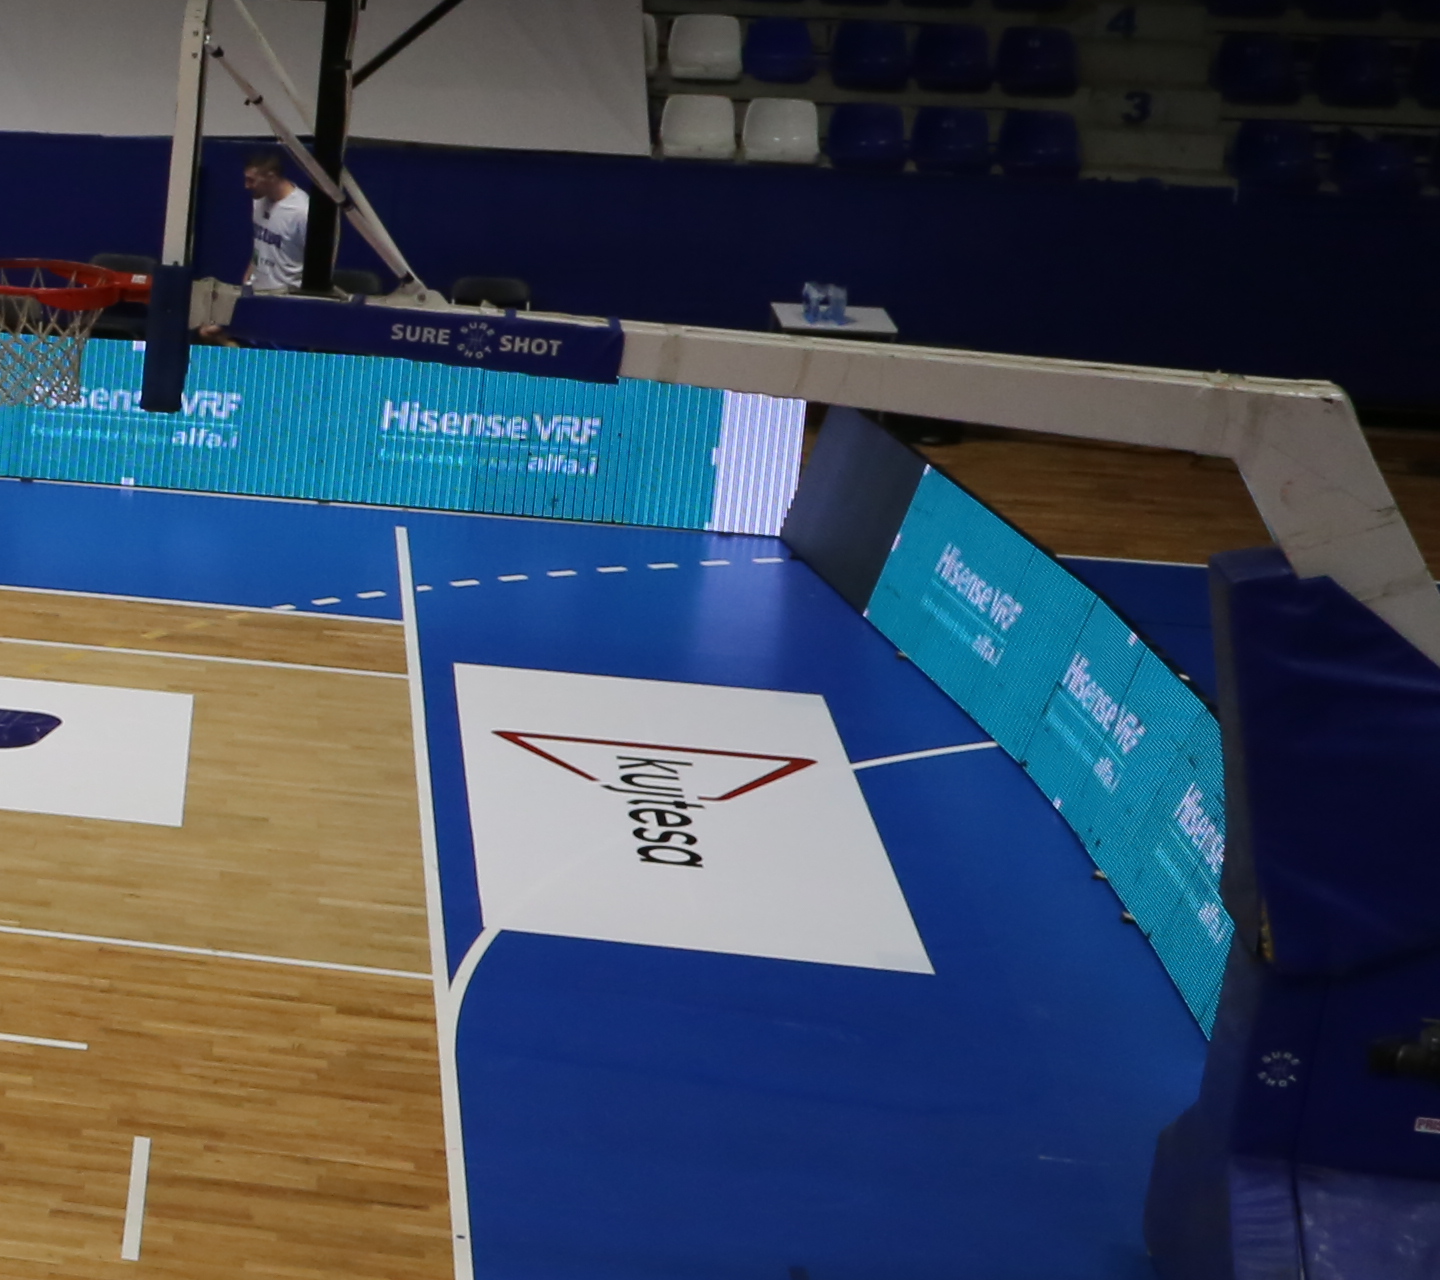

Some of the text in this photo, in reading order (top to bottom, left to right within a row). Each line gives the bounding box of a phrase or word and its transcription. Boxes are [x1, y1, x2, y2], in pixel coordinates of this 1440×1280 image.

[1121, 91, 1153, 124] 3
[390, 322, 452, 347] SURE
[499, 334, 563, 358] SHOT
[179, 389, 244, 420] VRF
[379, 398, 603, 446] Hisense VRF
[932, 541, 997, 616] Hisense
[601, 755, 705, 869] kujtesa
